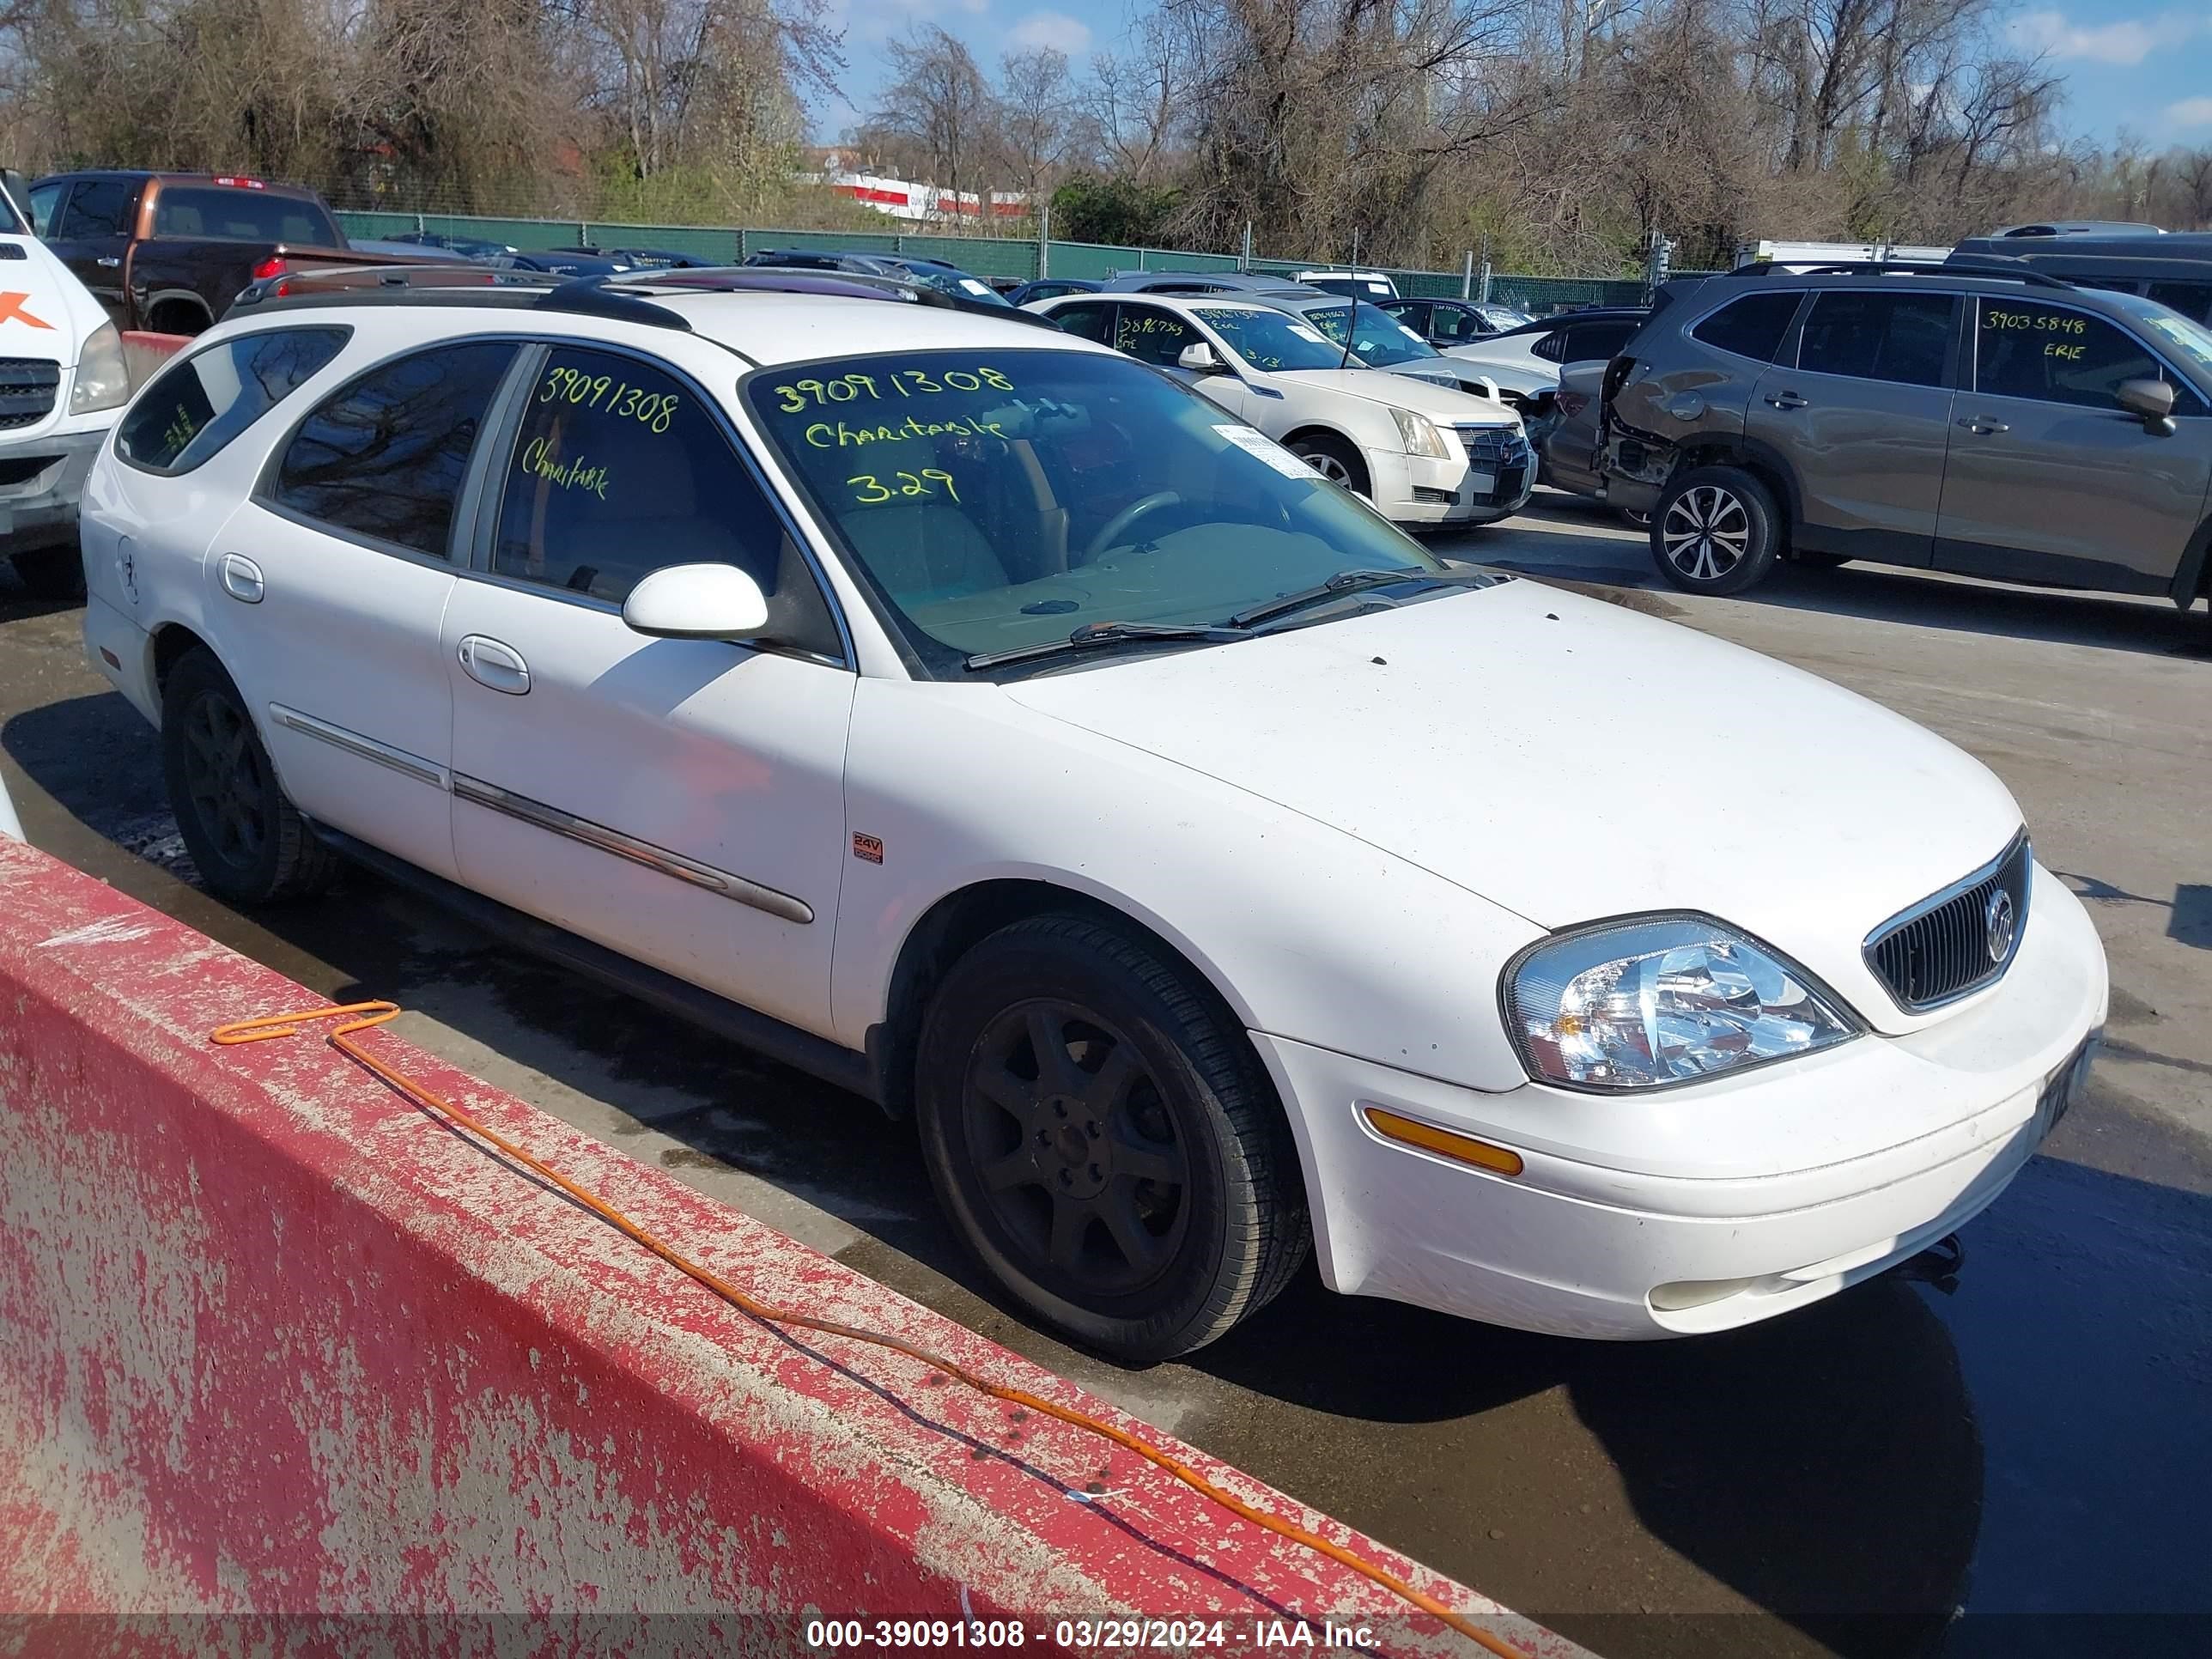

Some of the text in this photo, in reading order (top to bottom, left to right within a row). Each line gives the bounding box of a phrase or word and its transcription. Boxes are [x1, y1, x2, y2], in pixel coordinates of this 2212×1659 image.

[1982, 311, 2087, 334] 39035848
[2044, 343, 2087, 360] ERIE
[539, 367, 679, 434] 39091308
[774, 367, 1015, 413] 39091308
[846, 468, 962, 506] 3.29
[854, 834, 880, 851] 24V
